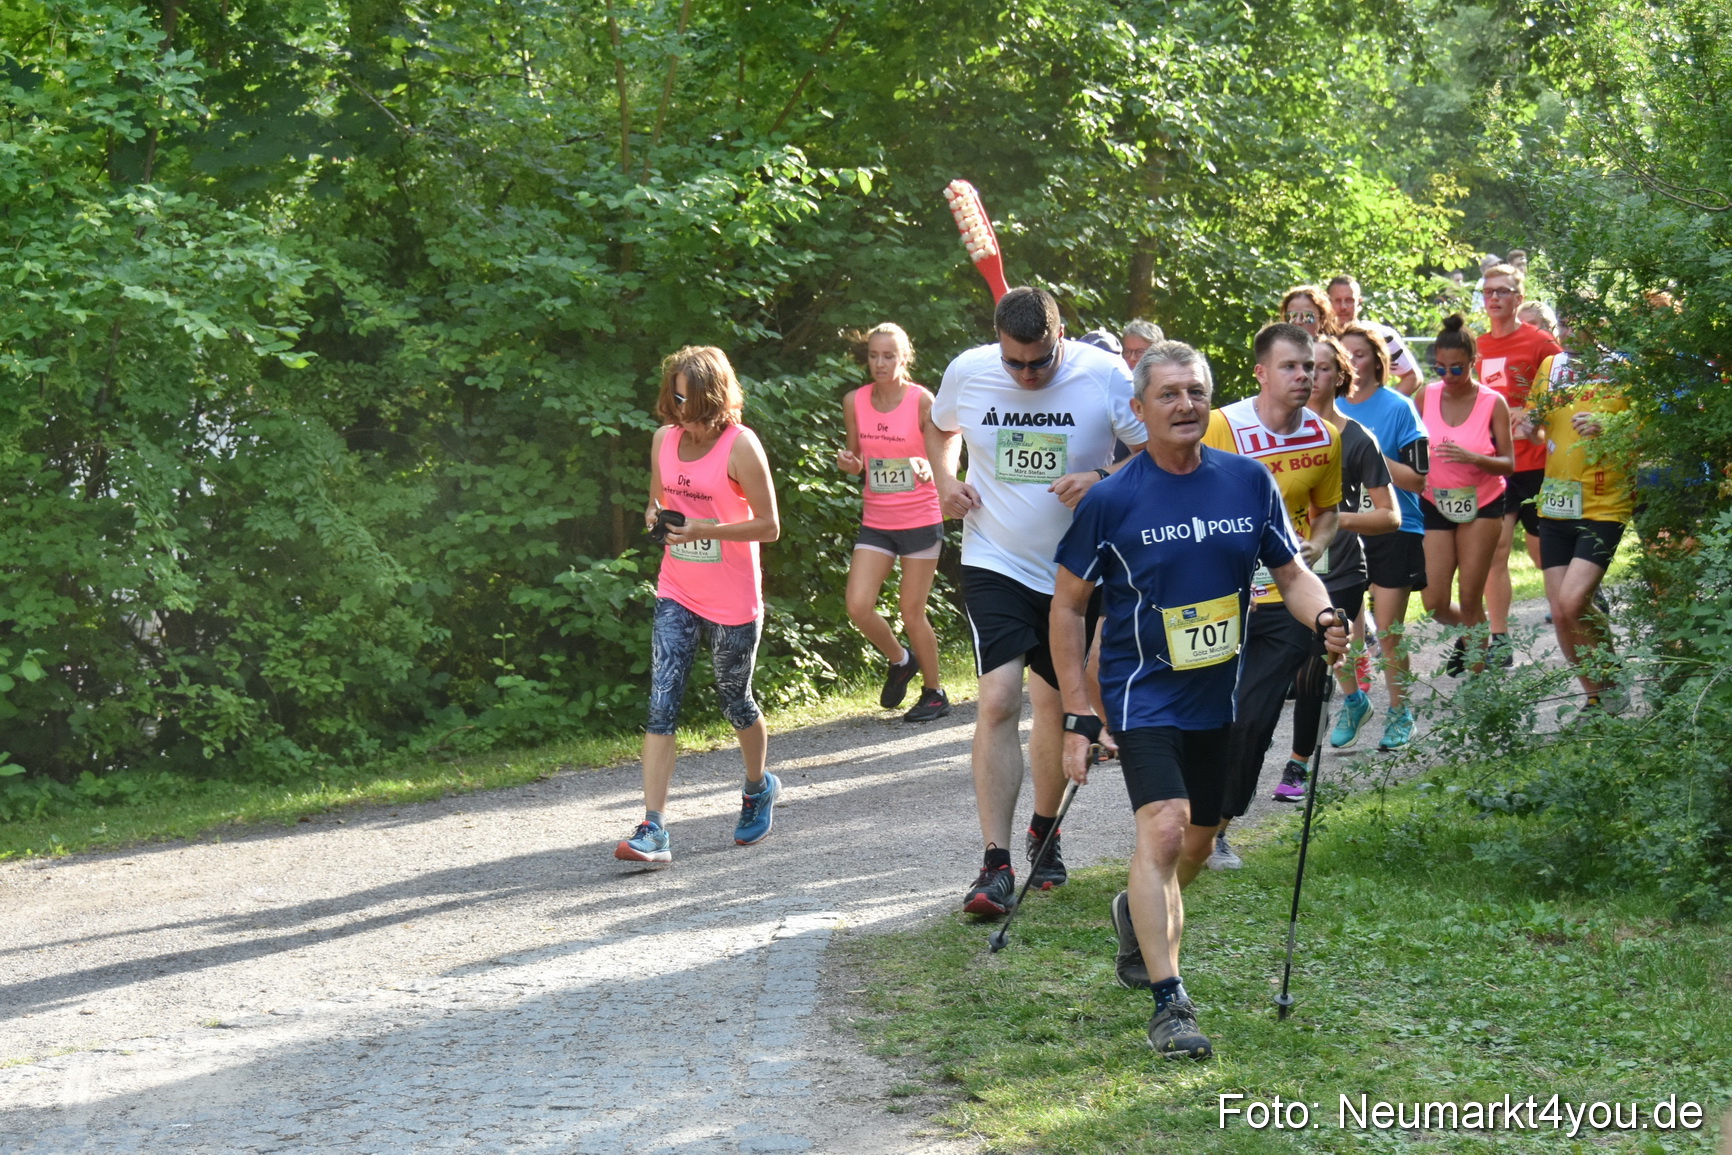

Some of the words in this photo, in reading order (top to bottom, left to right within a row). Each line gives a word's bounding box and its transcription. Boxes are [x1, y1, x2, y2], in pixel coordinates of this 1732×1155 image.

[877, 422, 889, 432] Die
[1002, 412, 1076, 427] MAGNA
[1005, 448, 1056, 470] 1503
[1289, 453, 1330, 471] BÖGL
[678, 474, 691, 488] Die
[873, 470, 906, 484] 1121
[1438, 499, 1472, 514] 1126
[1141, 523, 1191, 545] EURO
[1207, 516, 1254, 536] POLES
[1184, 619, 1229, 651] 707
[1209, 645, 1230, 654] Michael
